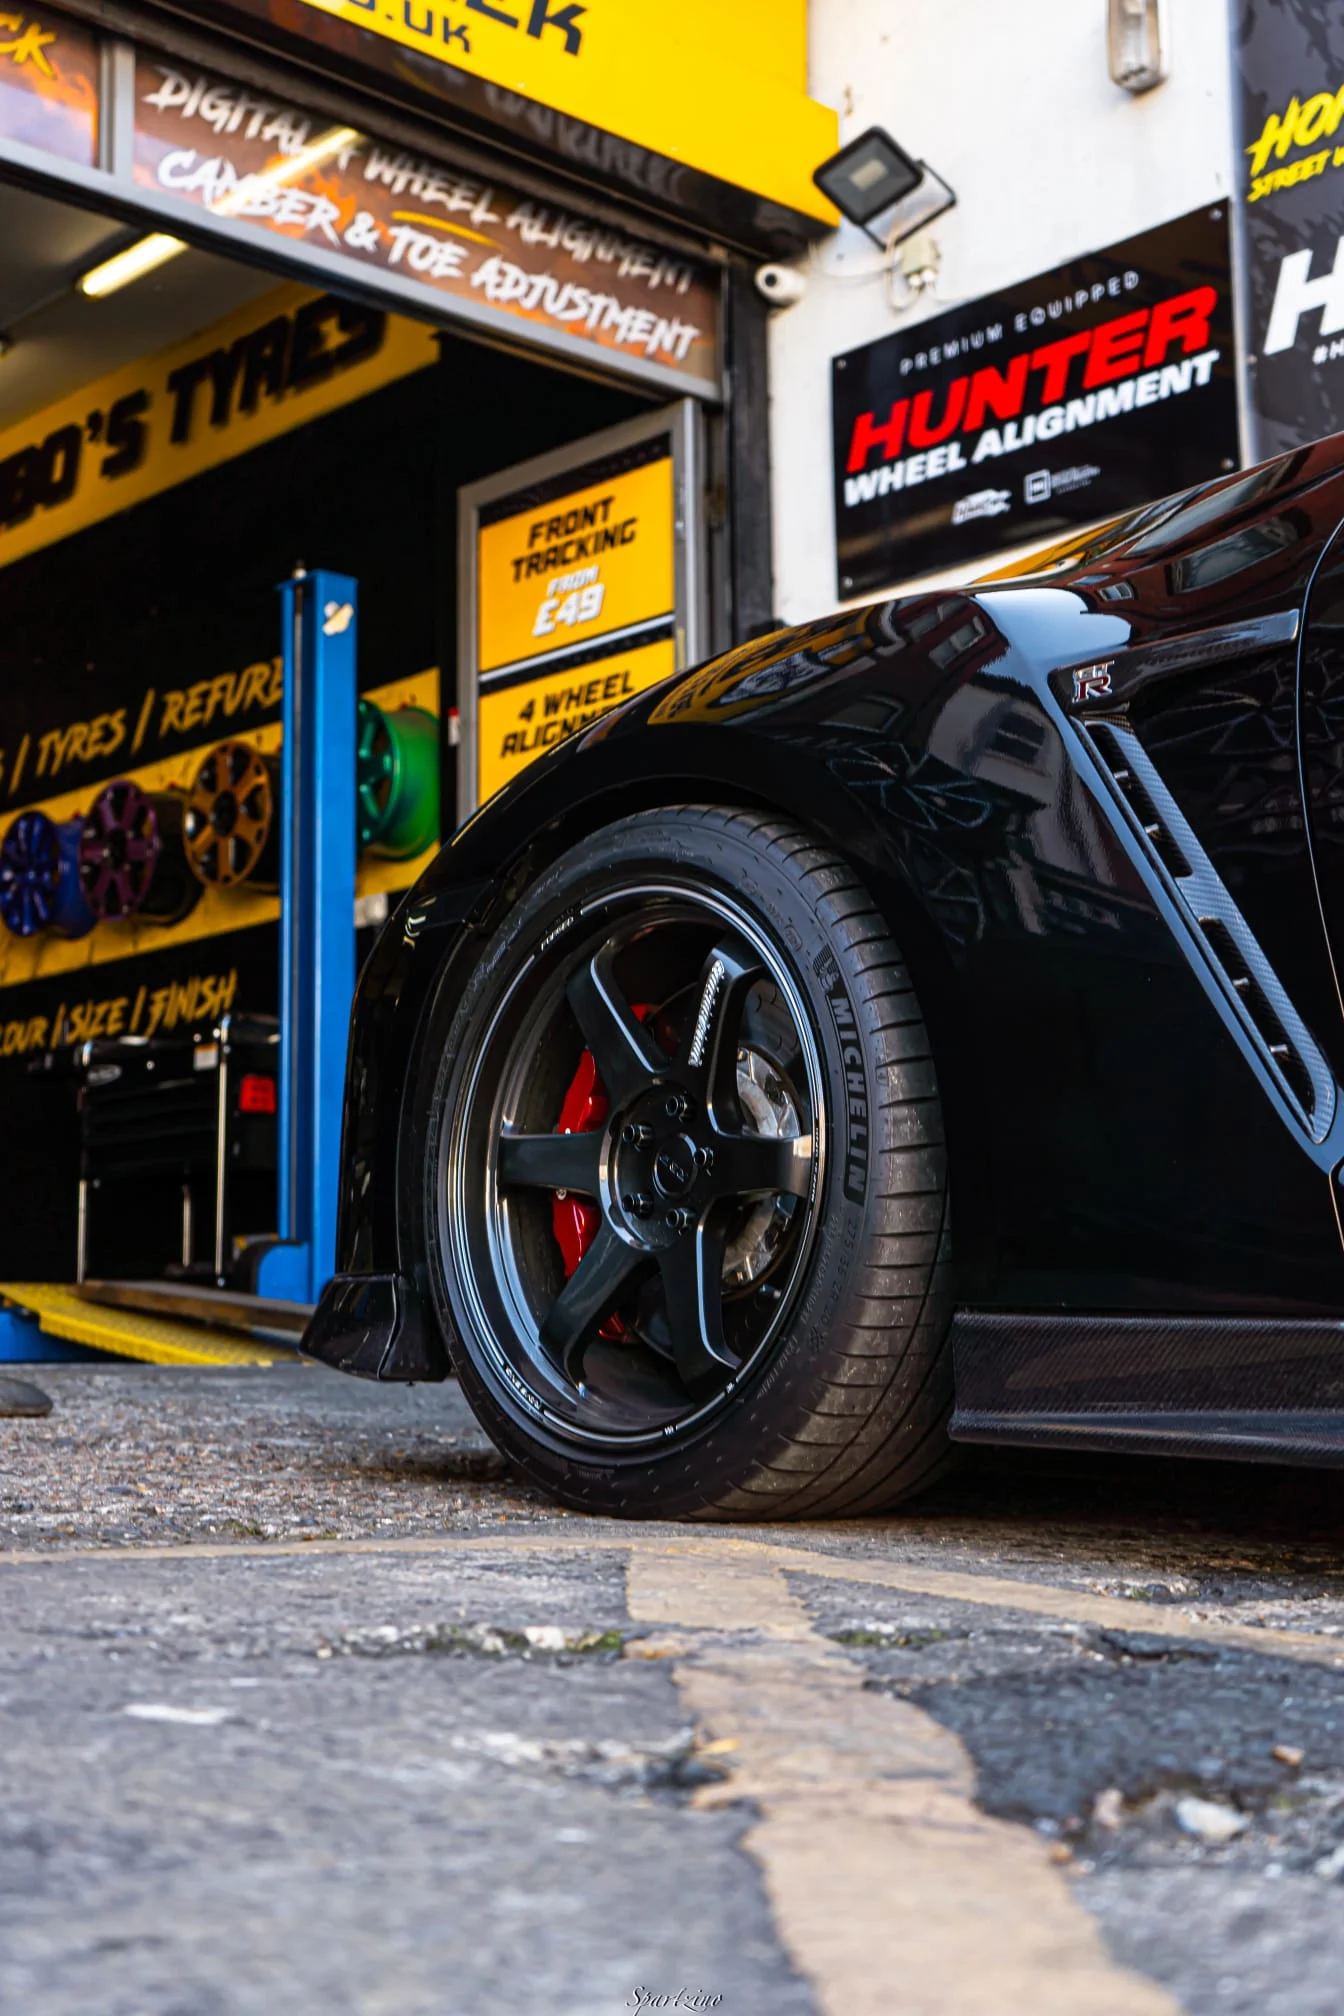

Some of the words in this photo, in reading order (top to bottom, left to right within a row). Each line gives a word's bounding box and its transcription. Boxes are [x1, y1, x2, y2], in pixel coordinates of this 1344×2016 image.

[143, 65, 312, 157] DIGITAL
[363, 146, 500, 226] WHEEL
[505, 199, 694, 296] ALIGNMENT
[1247, 149, 1332, 203] STREET
[158, 148, 340, 249] CAMBER
[344, 210, 380, 252] &
[388, 223, 469, 280] TOE
[470, 256, 702, 361] ADJUSTMENT
[899, 322, 1003, 377] PREMIUM
[1013, 270, 1140, 333] EQUIPPED
[845, 286, 1218, 473] HUNTER
[843, 440, 968, 508] WHEEL
[971, 348, 1222, 465] ALIGNMENT
[511, 516, 638, 584] TRACKING
[527, 495, 614, 549] FRONT
[531, 582, 606, 637] £49
[546, 564, 600, 597] FROM
[518, 697, 536, 724] 4
[543, 670, 635, 717] WHEEL
[35, 706, 127, 777] TYRES
[66, 999, 128, 1045] SIZE
[147, 968, 237, 1036] FINISH
[831, 996, 869, 1190] MICHELIN
